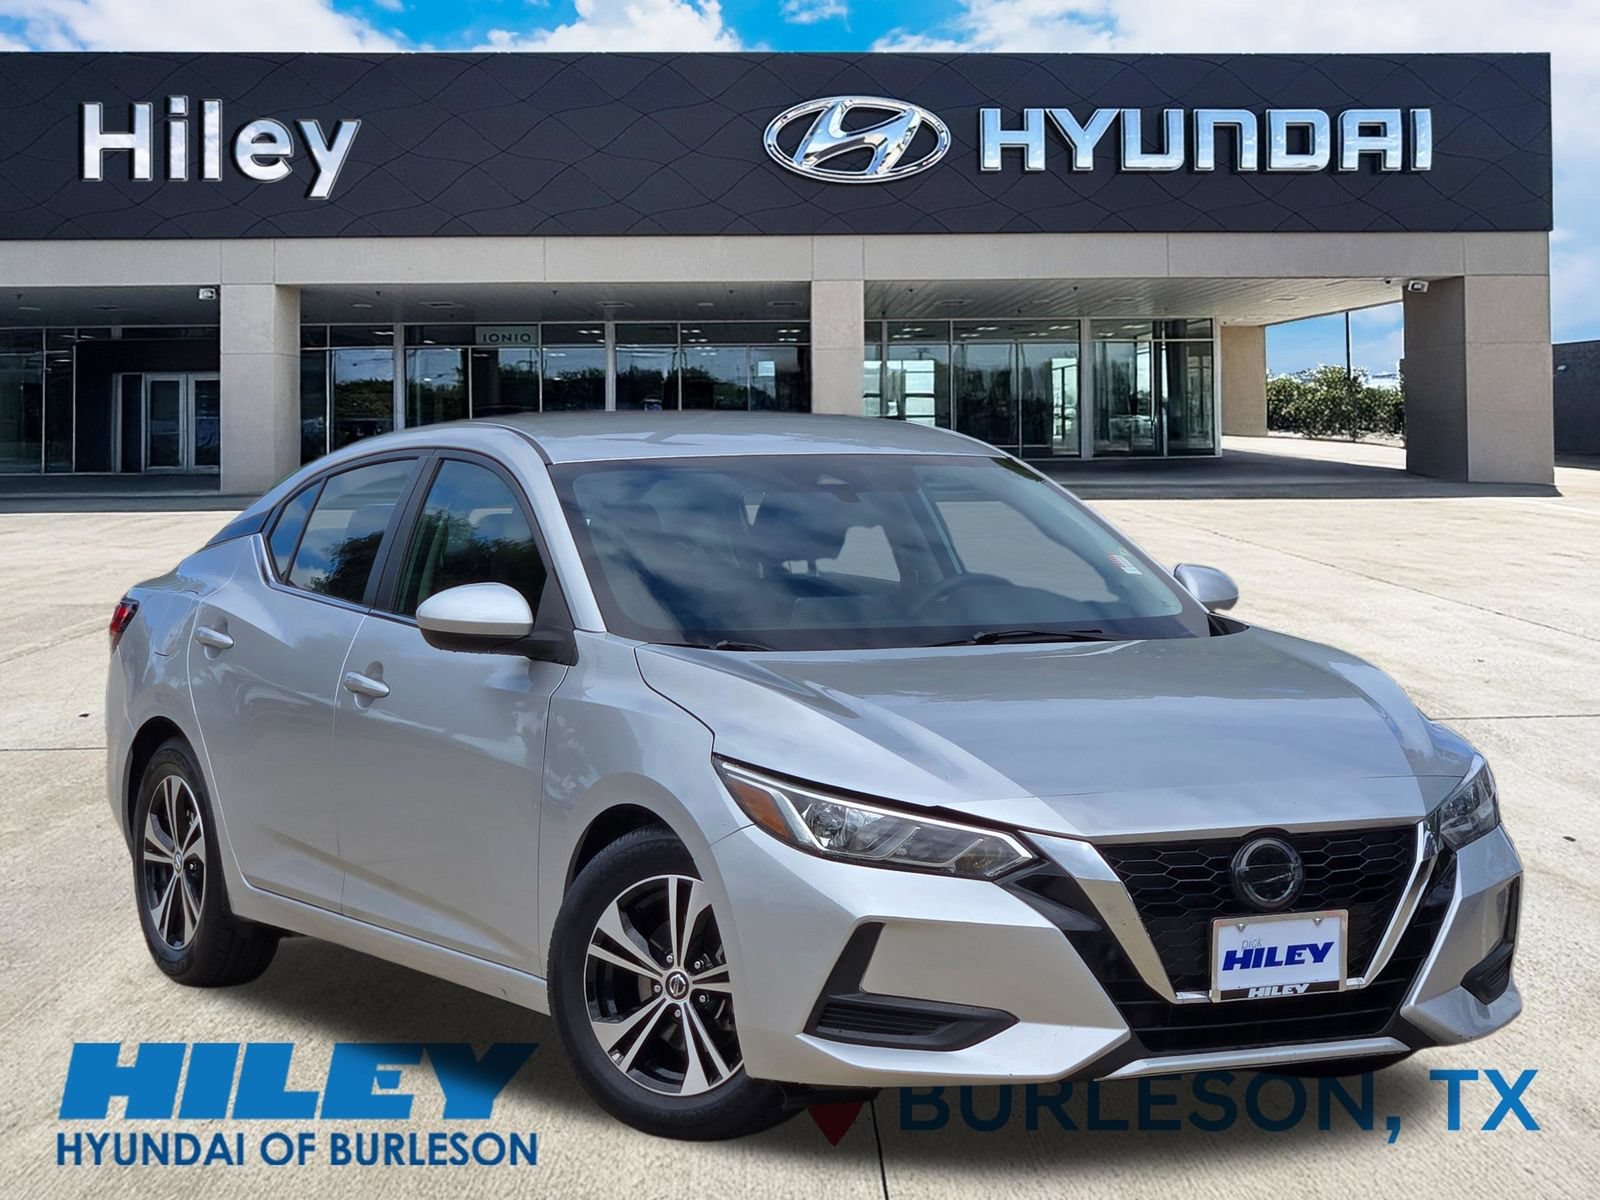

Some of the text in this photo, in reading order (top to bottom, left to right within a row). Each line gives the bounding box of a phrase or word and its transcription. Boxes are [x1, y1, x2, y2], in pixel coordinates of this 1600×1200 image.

[80, 95, 361, 199] Hiley
[980, 107, 1433, 172] HYUNDAI
[1222, 942, 1335, 971] HILEY
[1248, 983, 1310, 998] HILEY
